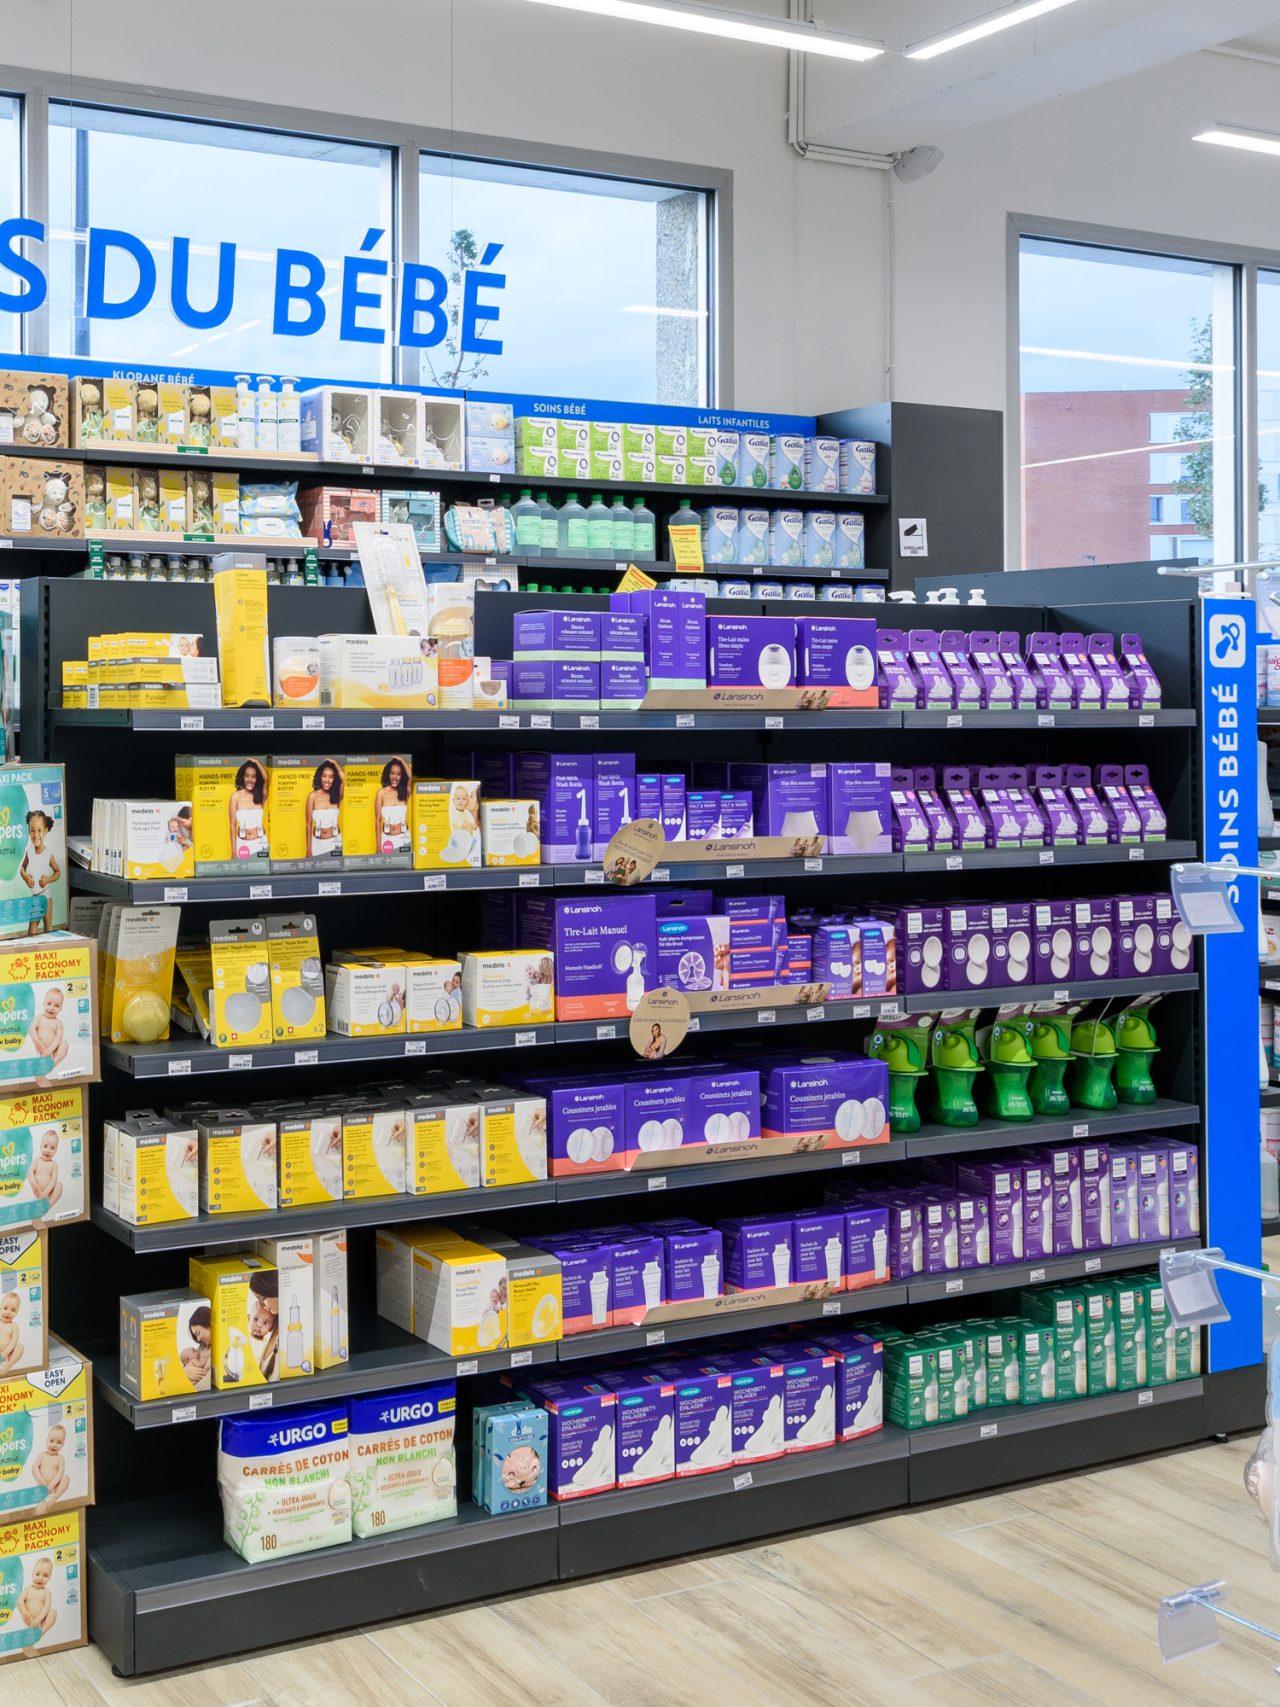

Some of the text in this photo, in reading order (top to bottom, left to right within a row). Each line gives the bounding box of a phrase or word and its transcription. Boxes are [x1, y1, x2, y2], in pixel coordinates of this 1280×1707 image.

[86, 227, 236, 329] DU
[272, 228, 506, 354] BÉBÉ
[113, 371, 195, 385] KLORANE BÉBÉ
[533, 402, 586, 415] SOINS BÉBÉ
[698, 416, 769, 429] LAITS INFANTILES
[721, 692, 763, 701] Lansinoh
[1212, 683, 1239, 777] BÉBÉ
[11, 772, 33, 782] PACK
[43, 788, 50, 798] 5
[570, 906, 602, 914] Lansinoh
[564, 925, 628, 937] Tire-Lait Manuel
[34, 951, 58, 961] MAXI
[35, 958, 82, 971] ECONOMY
[67, 983, 73, 992] 2
[4, 1037, 22, 1047] baby
[797, 1079, 829, 1088] Lansinoh
[31, 1094, 53, 1105] MAXI
[790, 1091, 846, 1103] Coussinets jetables
[32, 1100, 75, 1114] ECONOMY
[61, 1123, 67, 1133] 2
[5, 1182, 22, 1193] baby
[21, 1273, 27, 1282] 2
[44, 1368, 64, 1380] EASY
[44, 1377, 66, 1389] OPEN
[66, 1406, 72, 1415] 2
[389, 1402, 433, 1423] URGO
[279, 1422, 326, 1445] URGO
[357, 1428, 453, 1457] CARRÉS DE COTON
[243, 1449, 349, 1476] CARRÉS DE COTON
[376, 1447, 437, 1466] NON BLANCHI
[2, 1467, 20, 1477] baby
[264, 1470, 330, 1488] NON BLANCHI
[371, 1511, 385, 1527] 180
[23, 1520, 47, 1532] MAXI
[24, 1525, 71, 1542] ECONOMY
[260, 1535, 277, 1551] 180
[56, 1551, 62, 1560] 2
